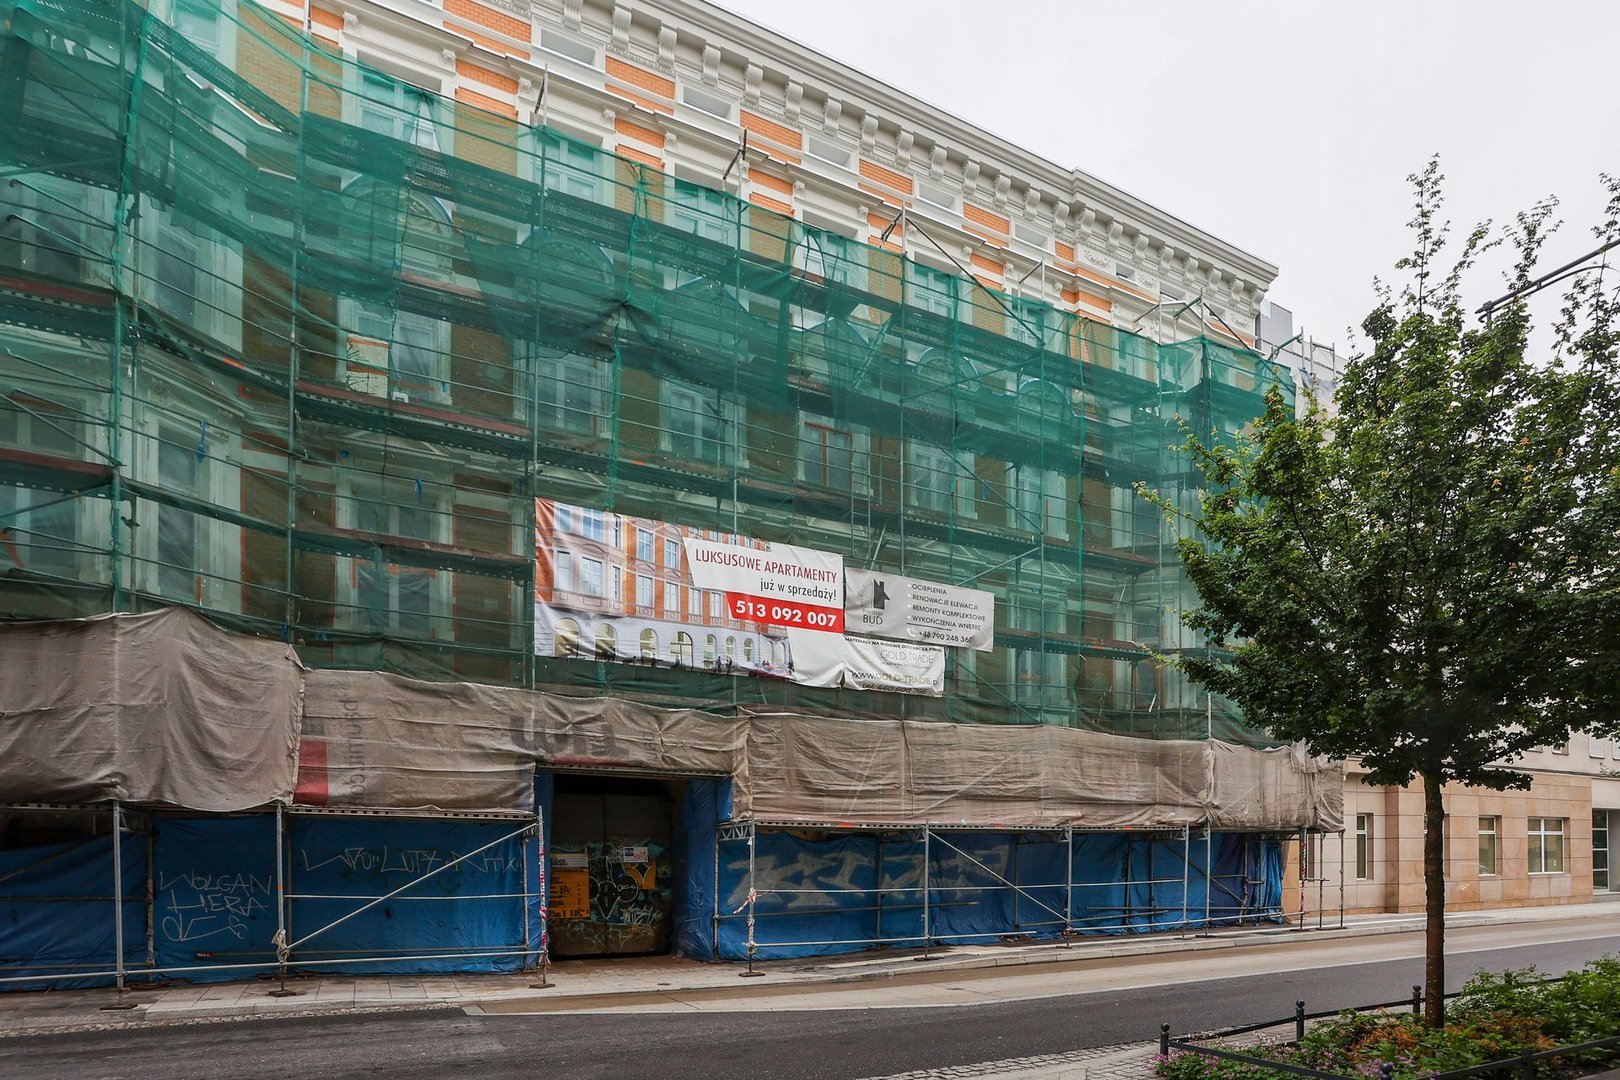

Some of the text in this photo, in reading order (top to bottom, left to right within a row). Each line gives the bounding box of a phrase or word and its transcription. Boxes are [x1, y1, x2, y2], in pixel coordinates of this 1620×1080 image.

[695, 549, 837, 584] LUKSUSOWE APARTAMENTY
[760, 578, 837, 602] już w sprzedaży!
[912, 583, 947, 595] OCIEPLENIA
[912, 594, 978, 610] RENOWACJE ELEWACJI
[735, 600, 837, 628] 513 092 007
[862, 614, 883, 625] BUD
[912, 605, 986, 621] REMONTY KOMPLEKSOWE
[932, 632, 945, 640] 790
[946, 634, 959, 642] 248
[909, 653, 934, 664] TRADE
